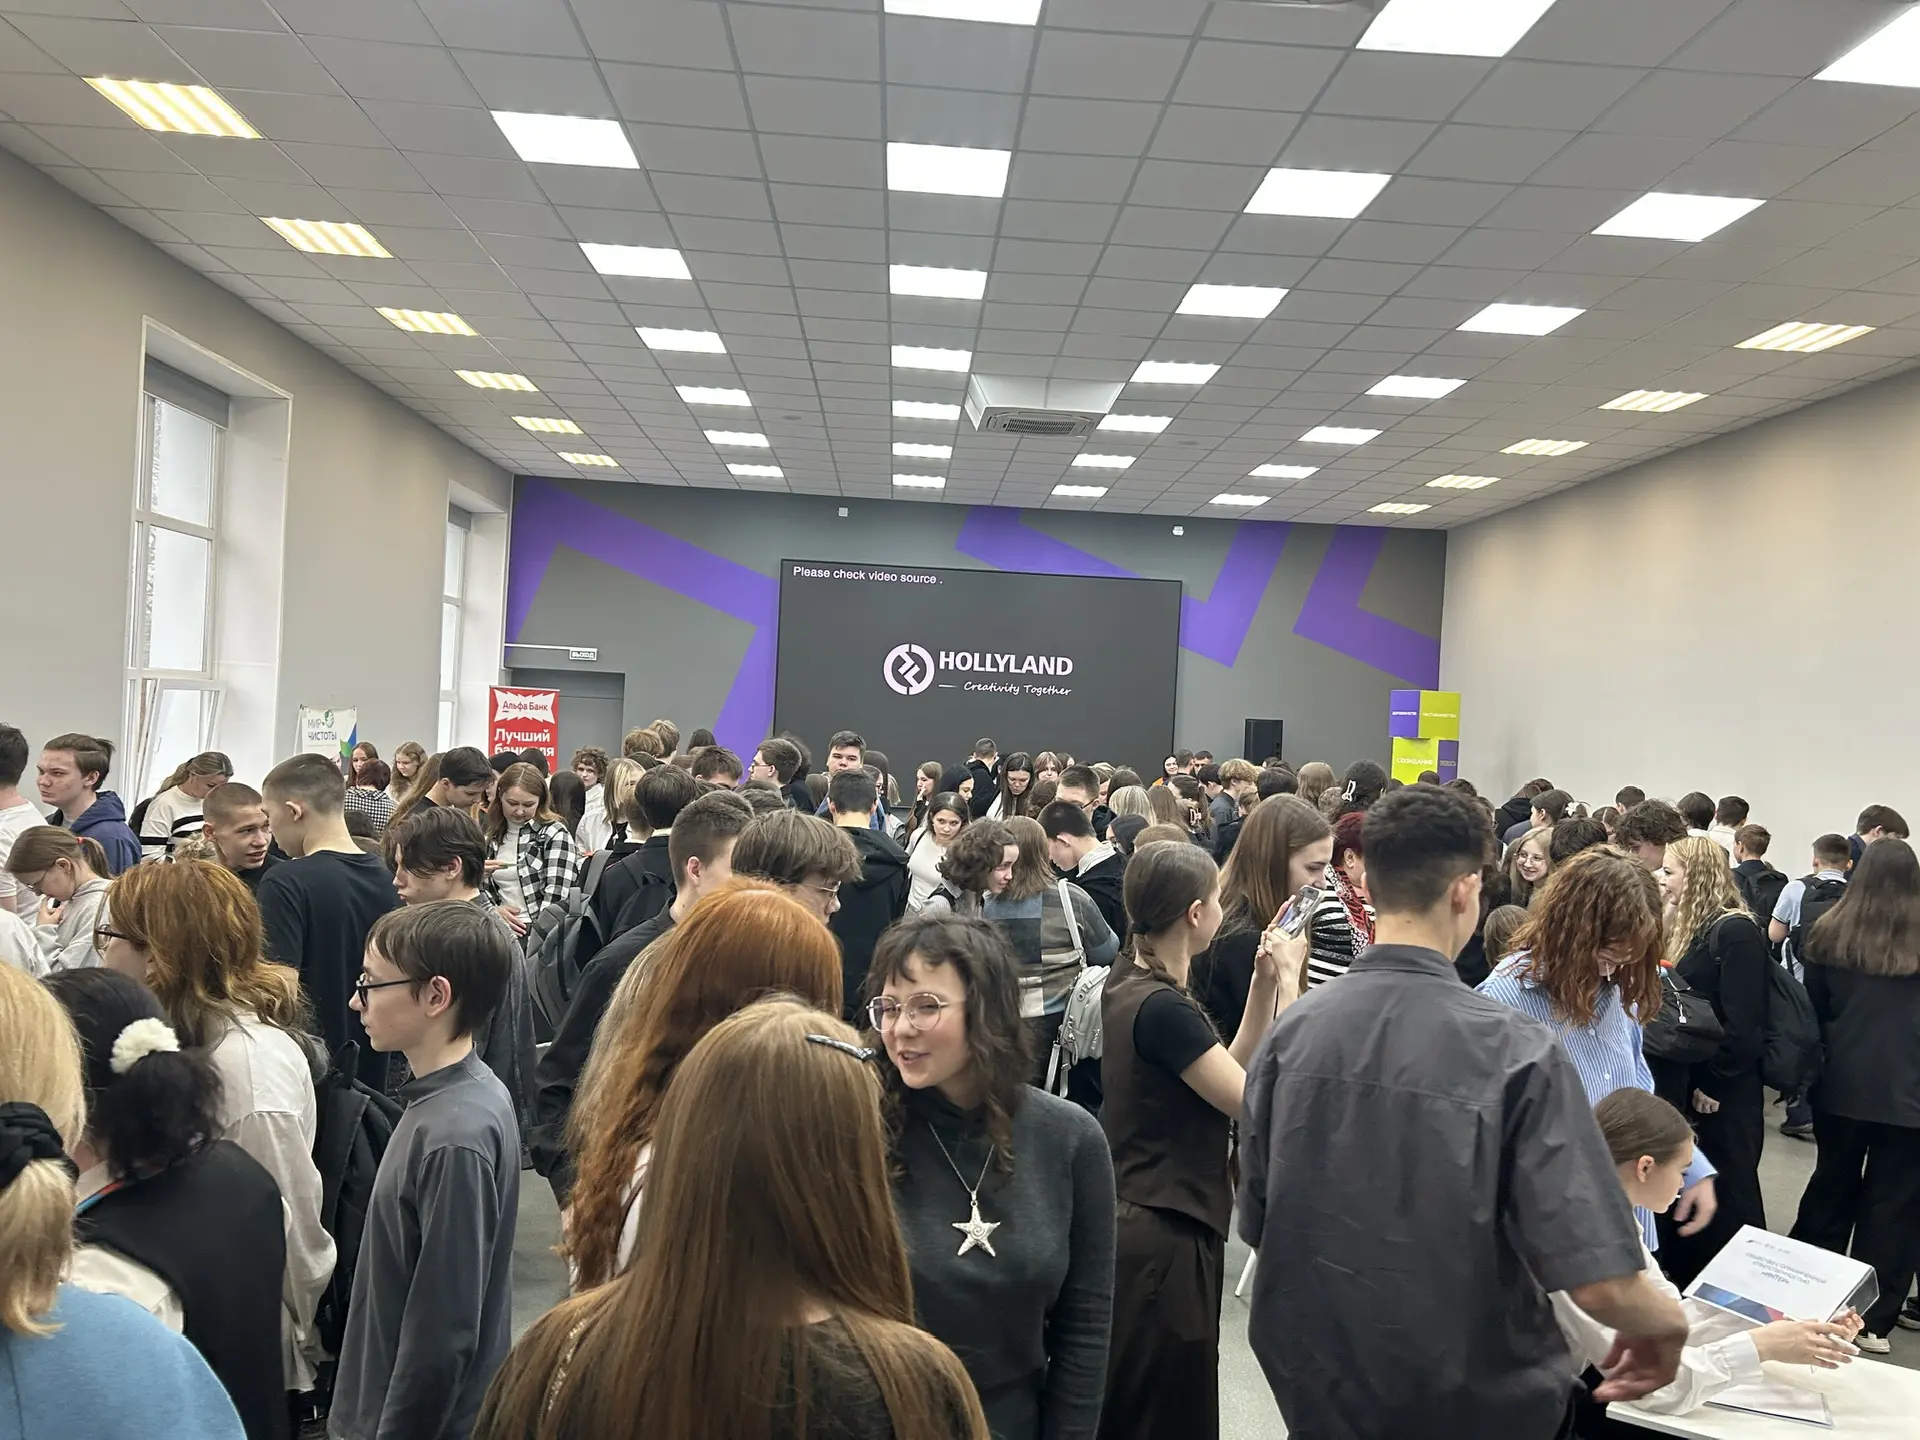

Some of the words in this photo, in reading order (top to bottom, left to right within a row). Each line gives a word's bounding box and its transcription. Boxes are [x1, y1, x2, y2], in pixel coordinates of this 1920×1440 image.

[793, 566, 830, 578] Please
[833, 568, 865, 580] check
[868, 570, 897, 582] video
[900, 574, 936, 584] source
[572, 651, 595, 659] ВЫХОД
[939, 650, 1073, 676] HOLLYLAND
[963, 681, 1019, 695] Creativity
[1024, 684, 1071, 696] Together
[502, 700, 528, 712] Альфа
[529, 702, 548, 711] Банк
[308, 718, 321, 728] МИР
[308, 731, 337, 741] ЧИСТОТЫ
[494, 728, 551, 744] Лучший
